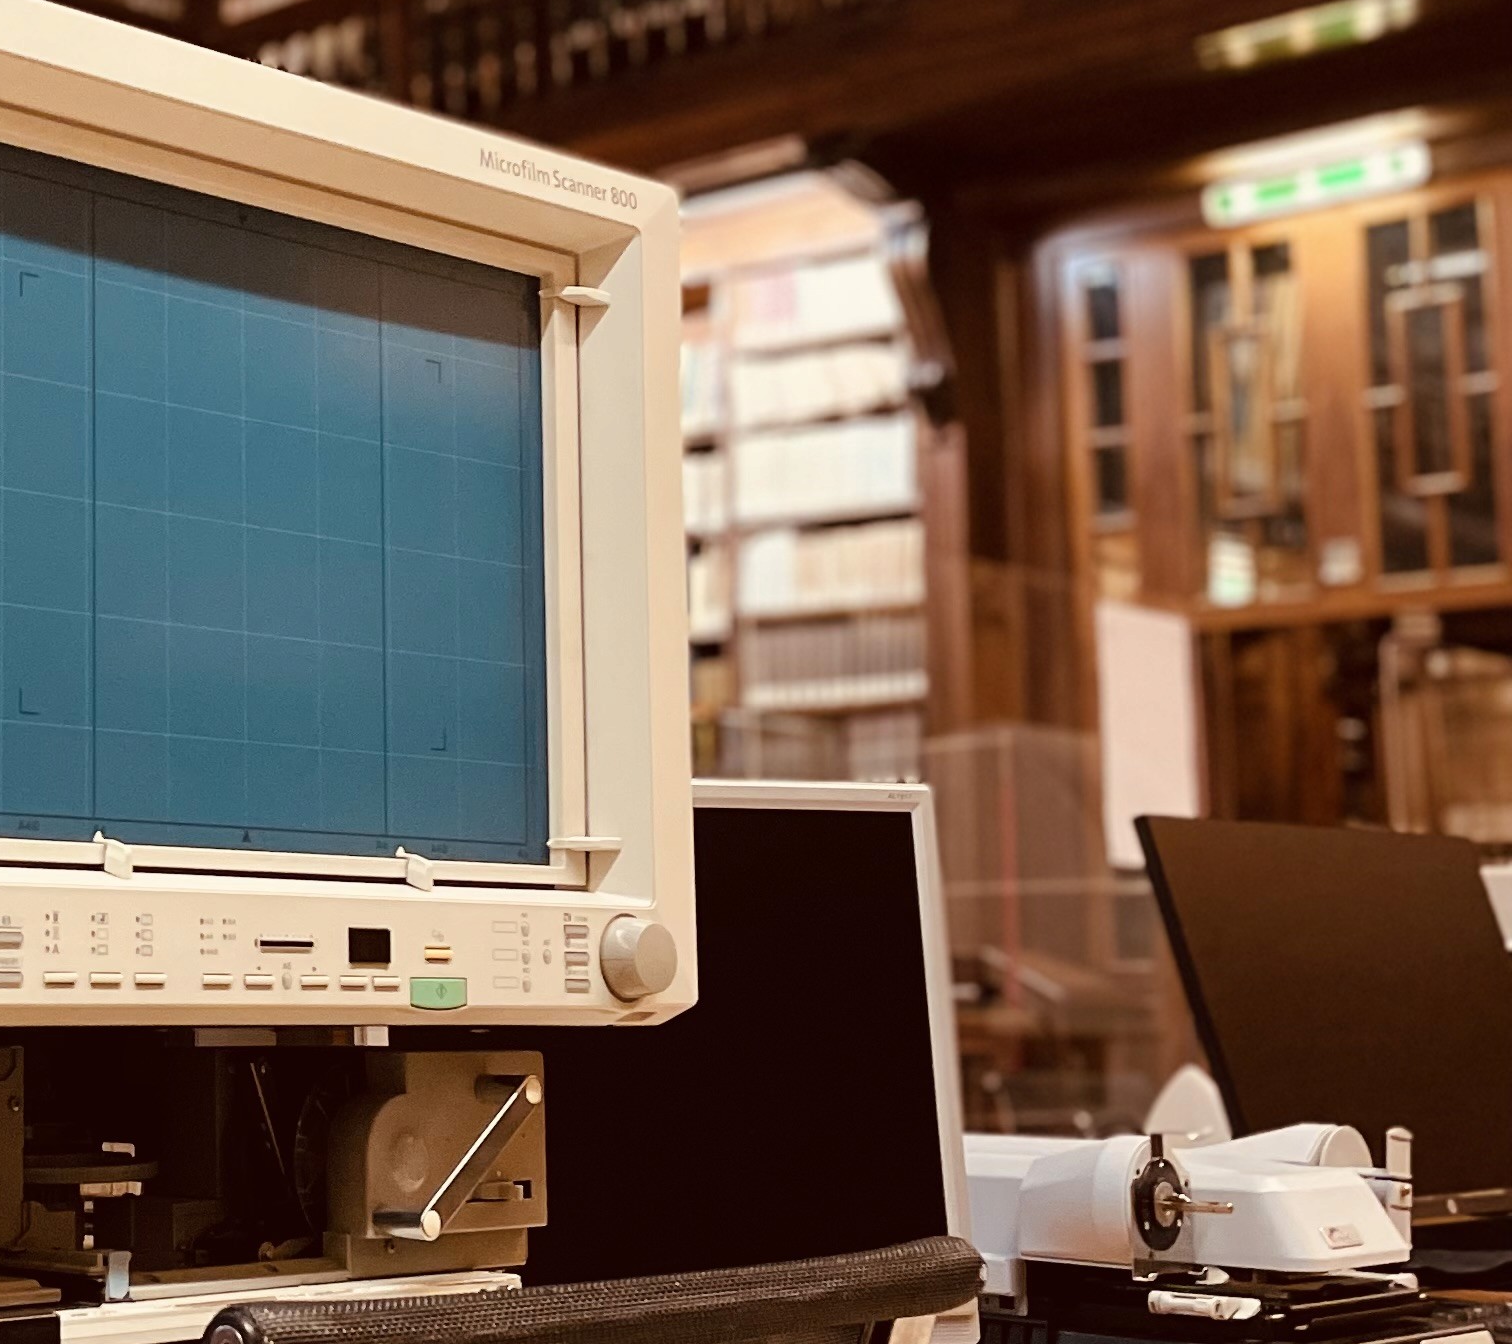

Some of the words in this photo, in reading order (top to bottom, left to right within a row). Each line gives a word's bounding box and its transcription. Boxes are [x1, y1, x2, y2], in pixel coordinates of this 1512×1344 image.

[479, 147, 551, 186] Microfilm
[552, 169, 607, 201] Scanner
[610, 186, 638, 210] 800
